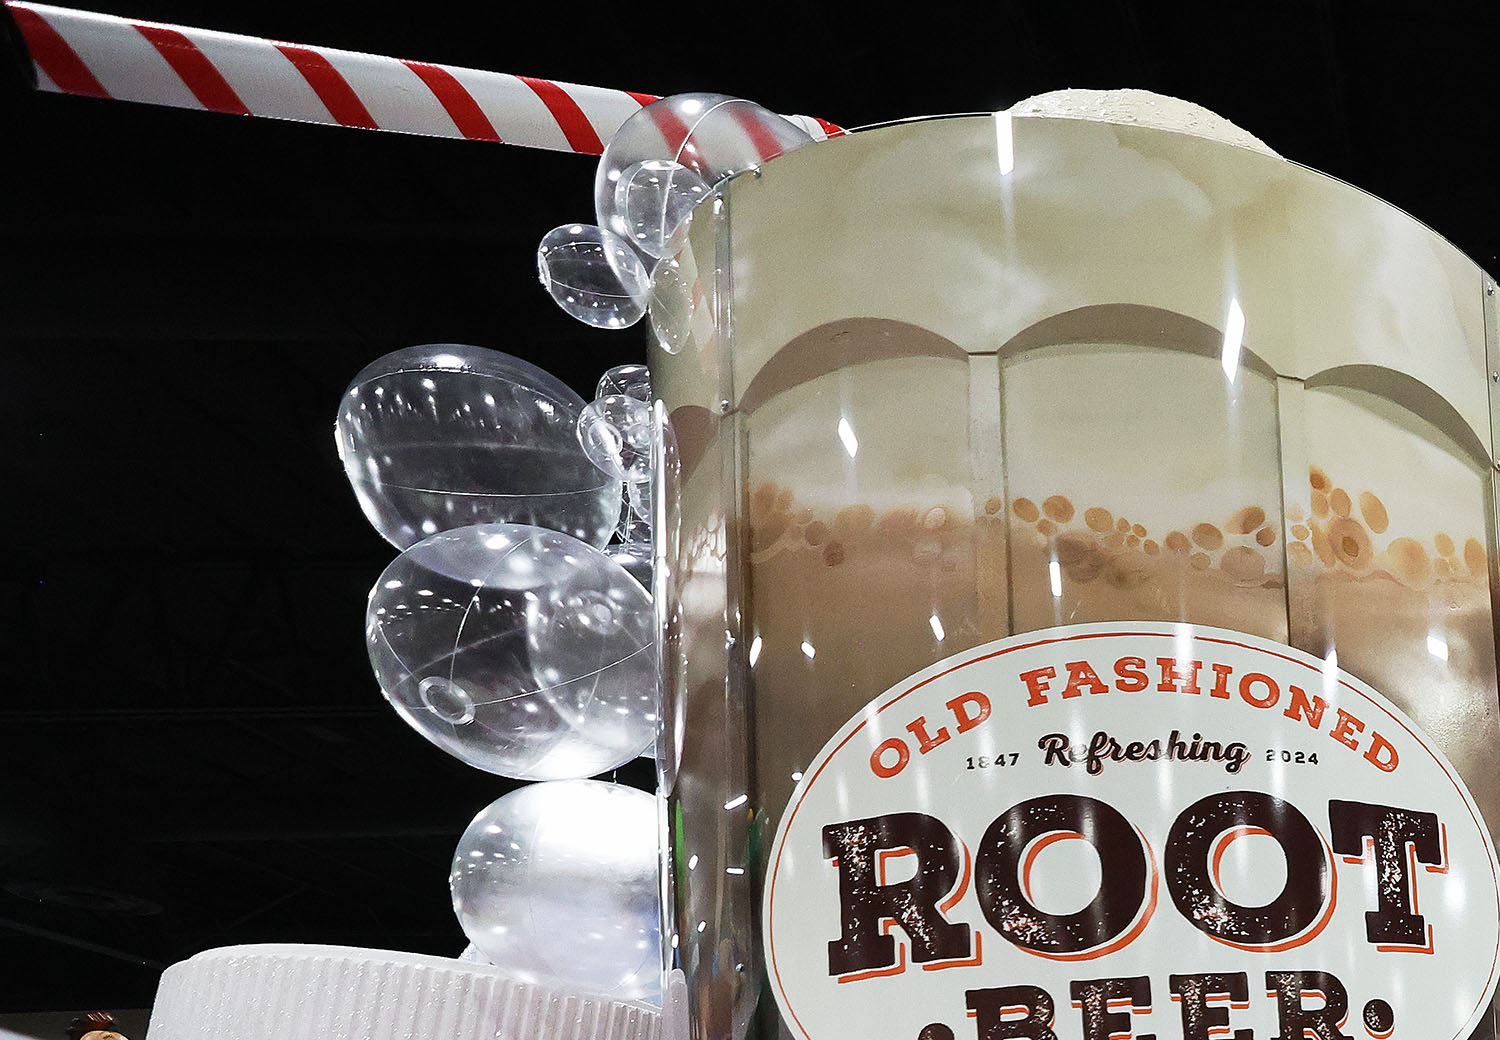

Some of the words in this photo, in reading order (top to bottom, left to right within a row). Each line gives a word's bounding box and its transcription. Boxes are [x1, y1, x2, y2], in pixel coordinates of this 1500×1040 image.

[869, 689, 992, 781] OLD
[1020, 656, 1401, 776] FASHIONED
[966, 752, 1020, 770] 1847
[1038, 730, 1251, 776] Refreshing
[1265, 749, 1320, 766] 2024
[822, 790, 1450, 983] ROOT
